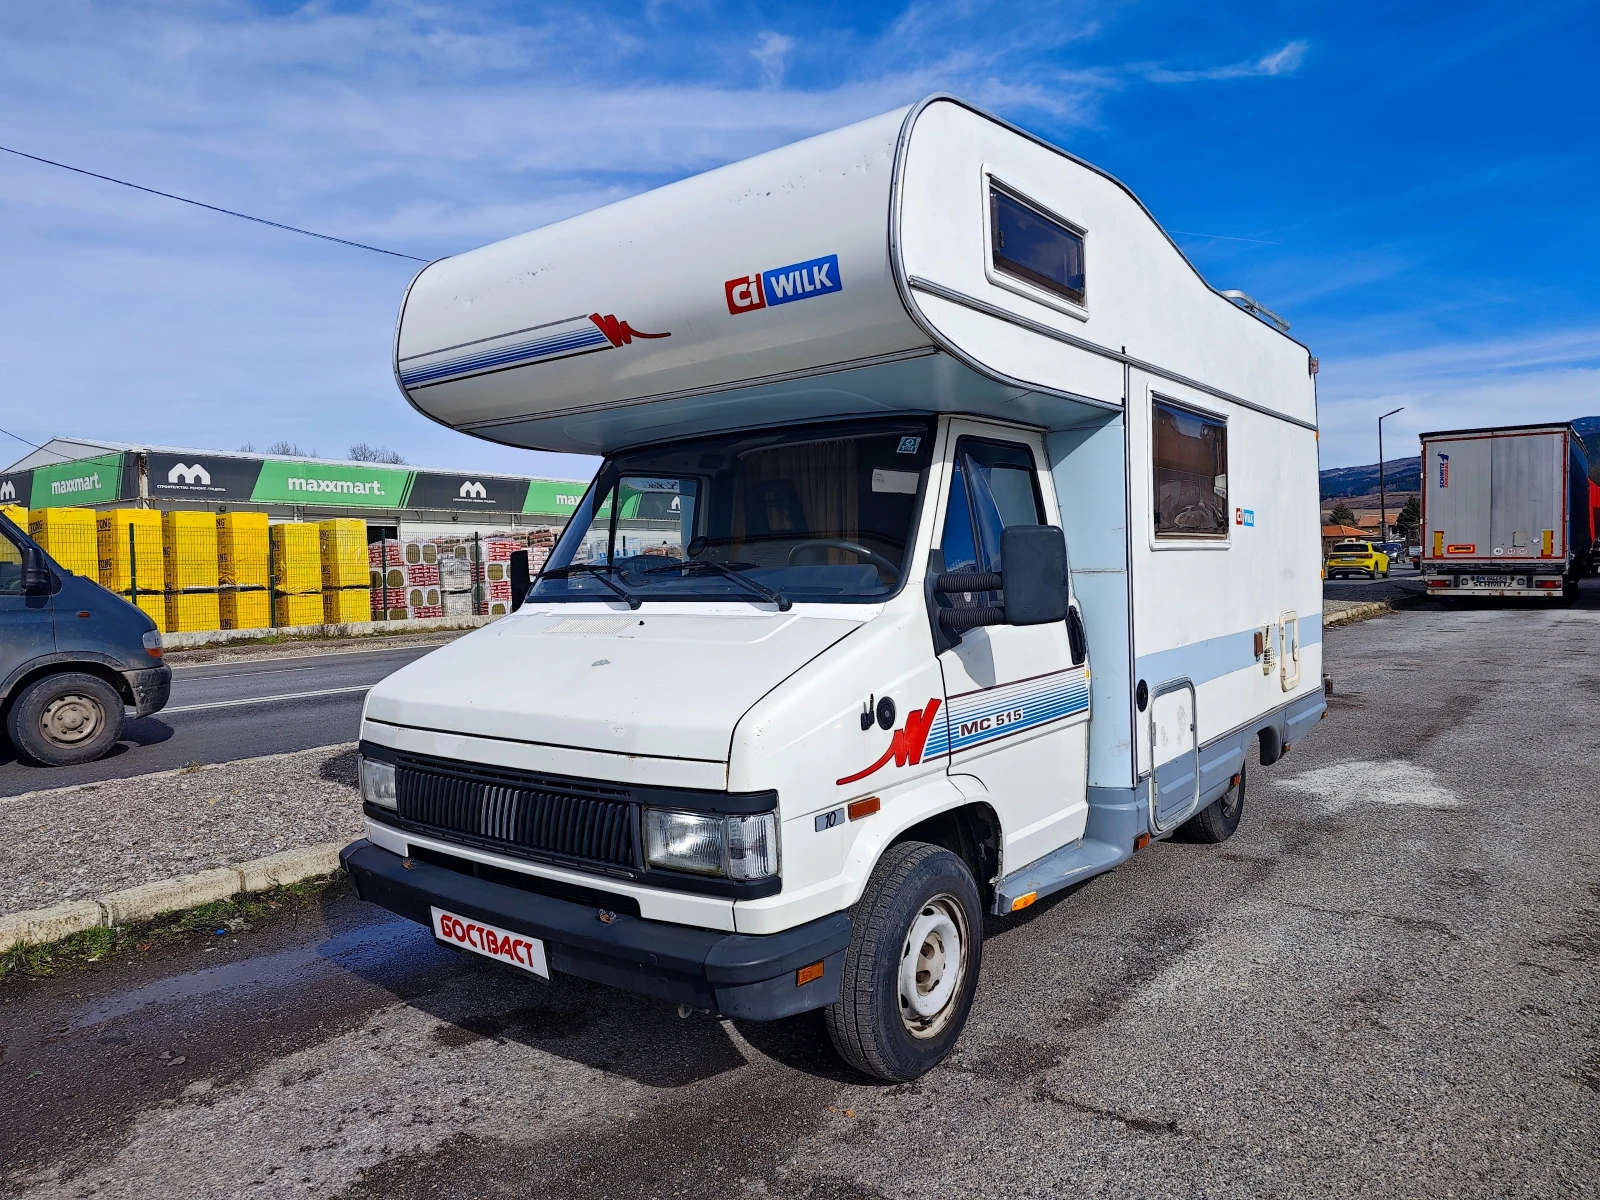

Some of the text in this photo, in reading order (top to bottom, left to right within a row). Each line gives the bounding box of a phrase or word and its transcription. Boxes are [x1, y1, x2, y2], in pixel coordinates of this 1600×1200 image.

[770, 263, 834, 299] WILK
[287, 477, 386, 496] maxxmart.
[960, 709, 1022, 738] MC 515
